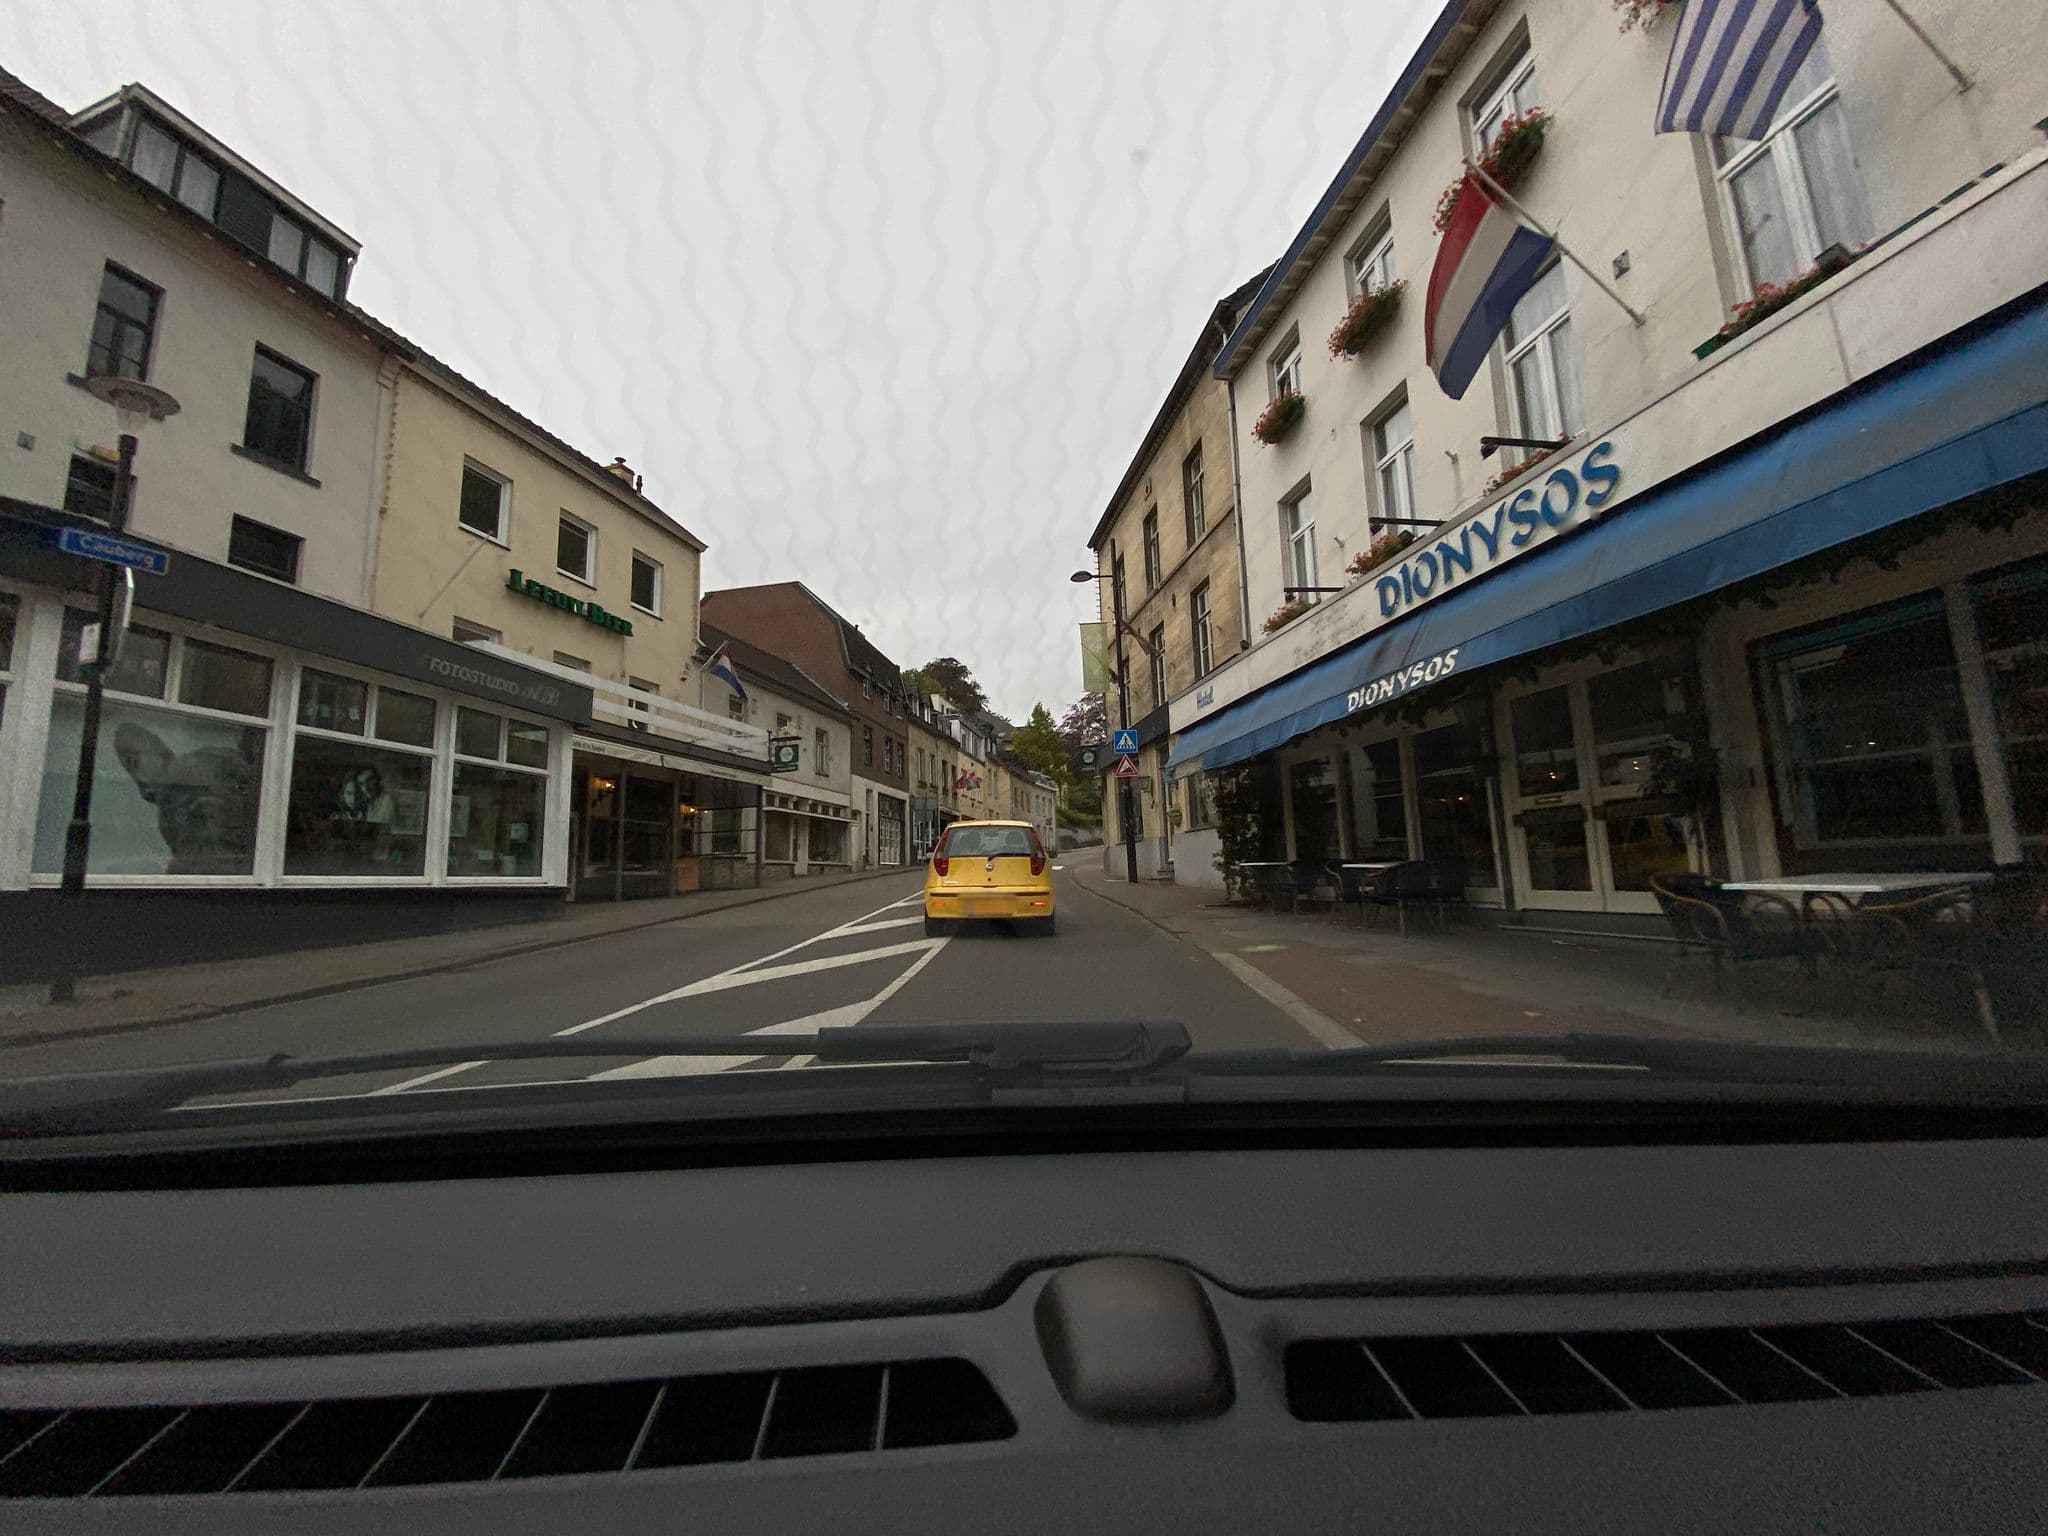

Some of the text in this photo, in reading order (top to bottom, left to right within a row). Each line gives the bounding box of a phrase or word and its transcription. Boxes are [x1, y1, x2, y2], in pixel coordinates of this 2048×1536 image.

[80, 536, 154, 567] Cauberg
[1374, 441, 1620, 617] DIONYSOS
[428, 657, 519, 696] FOTOSTUDIO
[1347, 648, 1460, 713] DIONYSOS
